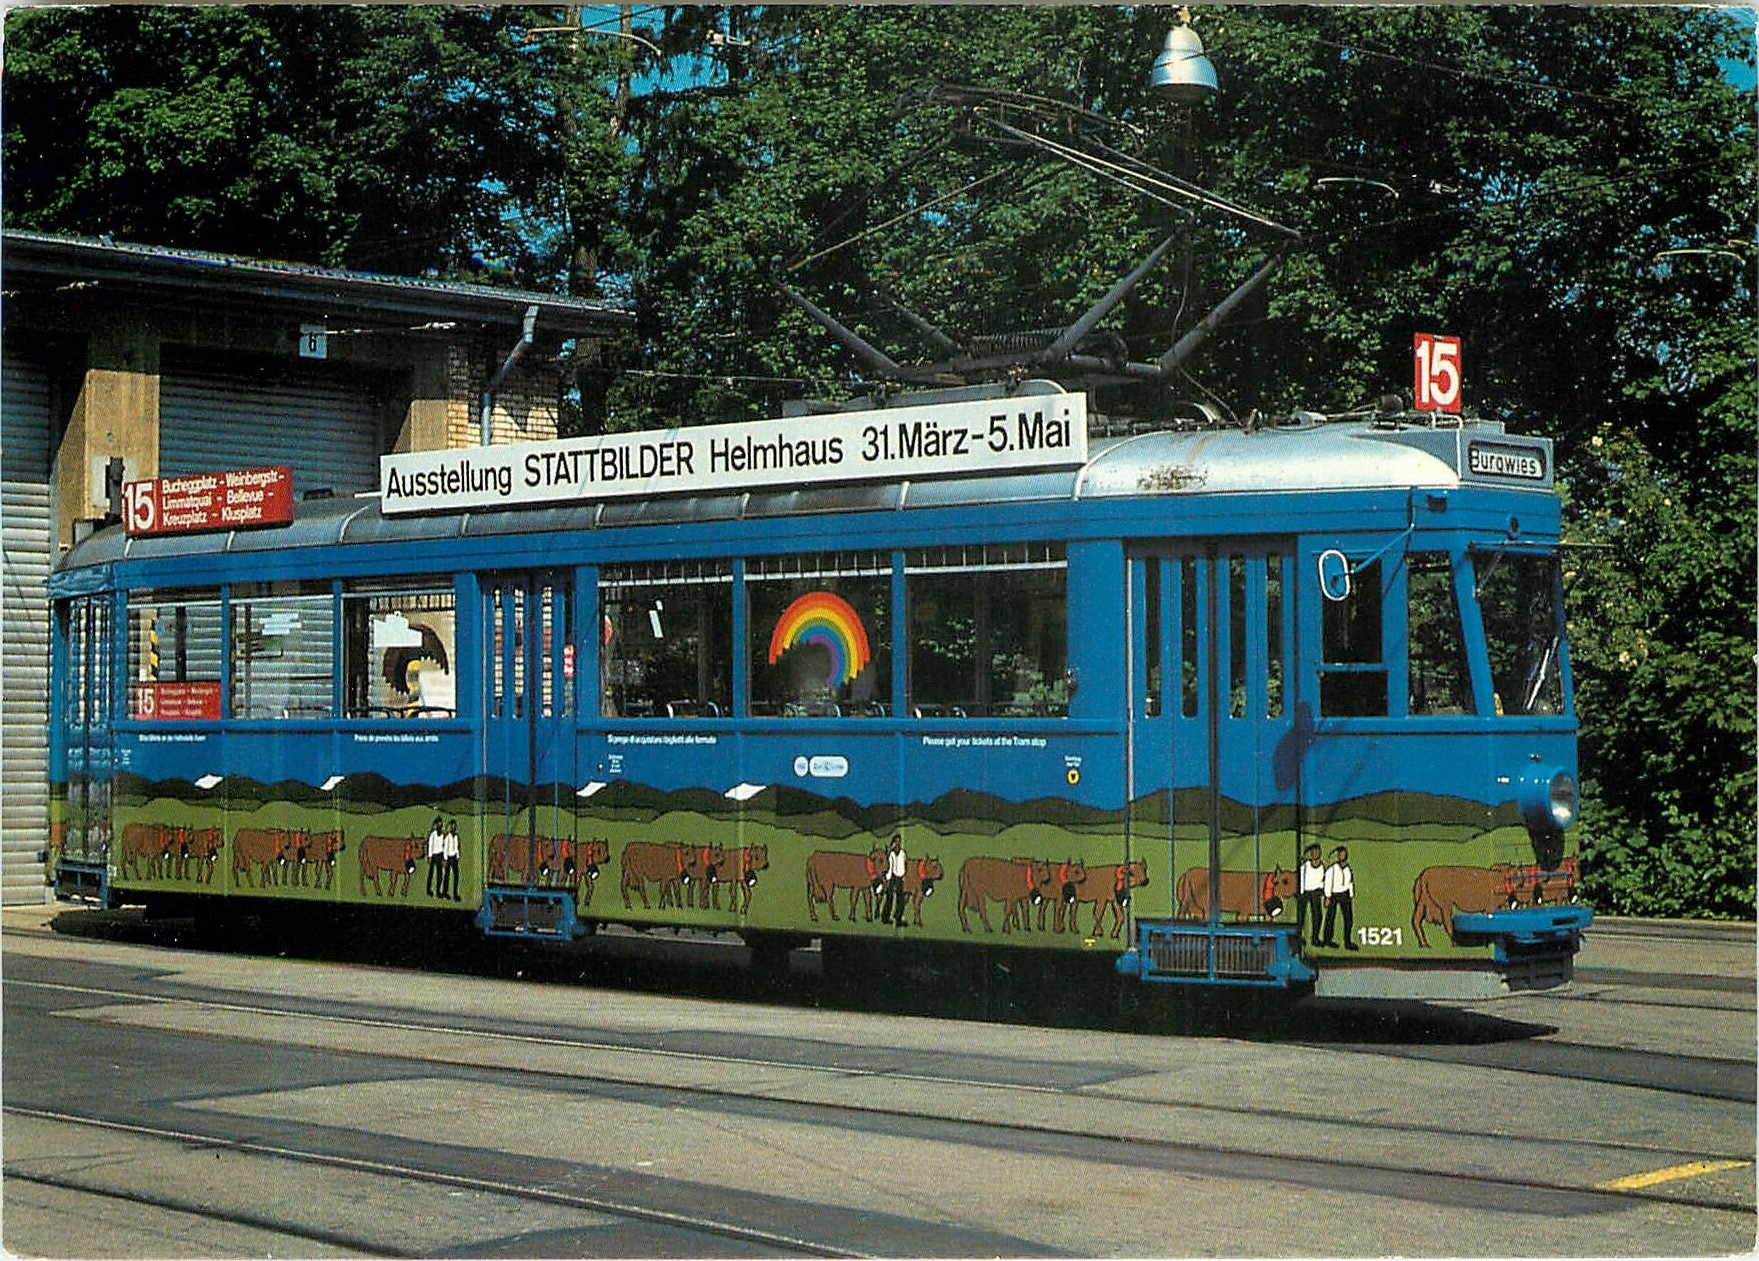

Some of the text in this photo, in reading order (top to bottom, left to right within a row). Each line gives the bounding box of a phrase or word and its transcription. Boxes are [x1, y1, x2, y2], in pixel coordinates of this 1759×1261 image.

[1416, 340, 1460, 405] 15
[386, 460, 513, 499] Ausstellung
[524, 440, 696, 488] STATTBILDER
[710, 433, 844, 473] Helmhaus
[162, 475, 218, 494] Bucheggplatz
[123, 482, 155, 531] 15
[162, 492, 213, 511] Limmatquai
[226, 489, 265, 505] Bellevue
[163, 509, 208, 528] Kreuzplatz
[221, 505, 263, 524] Klusplatz
[137, 687, 155, 715] 15
[1357, 927, 1402, 946] 1521
